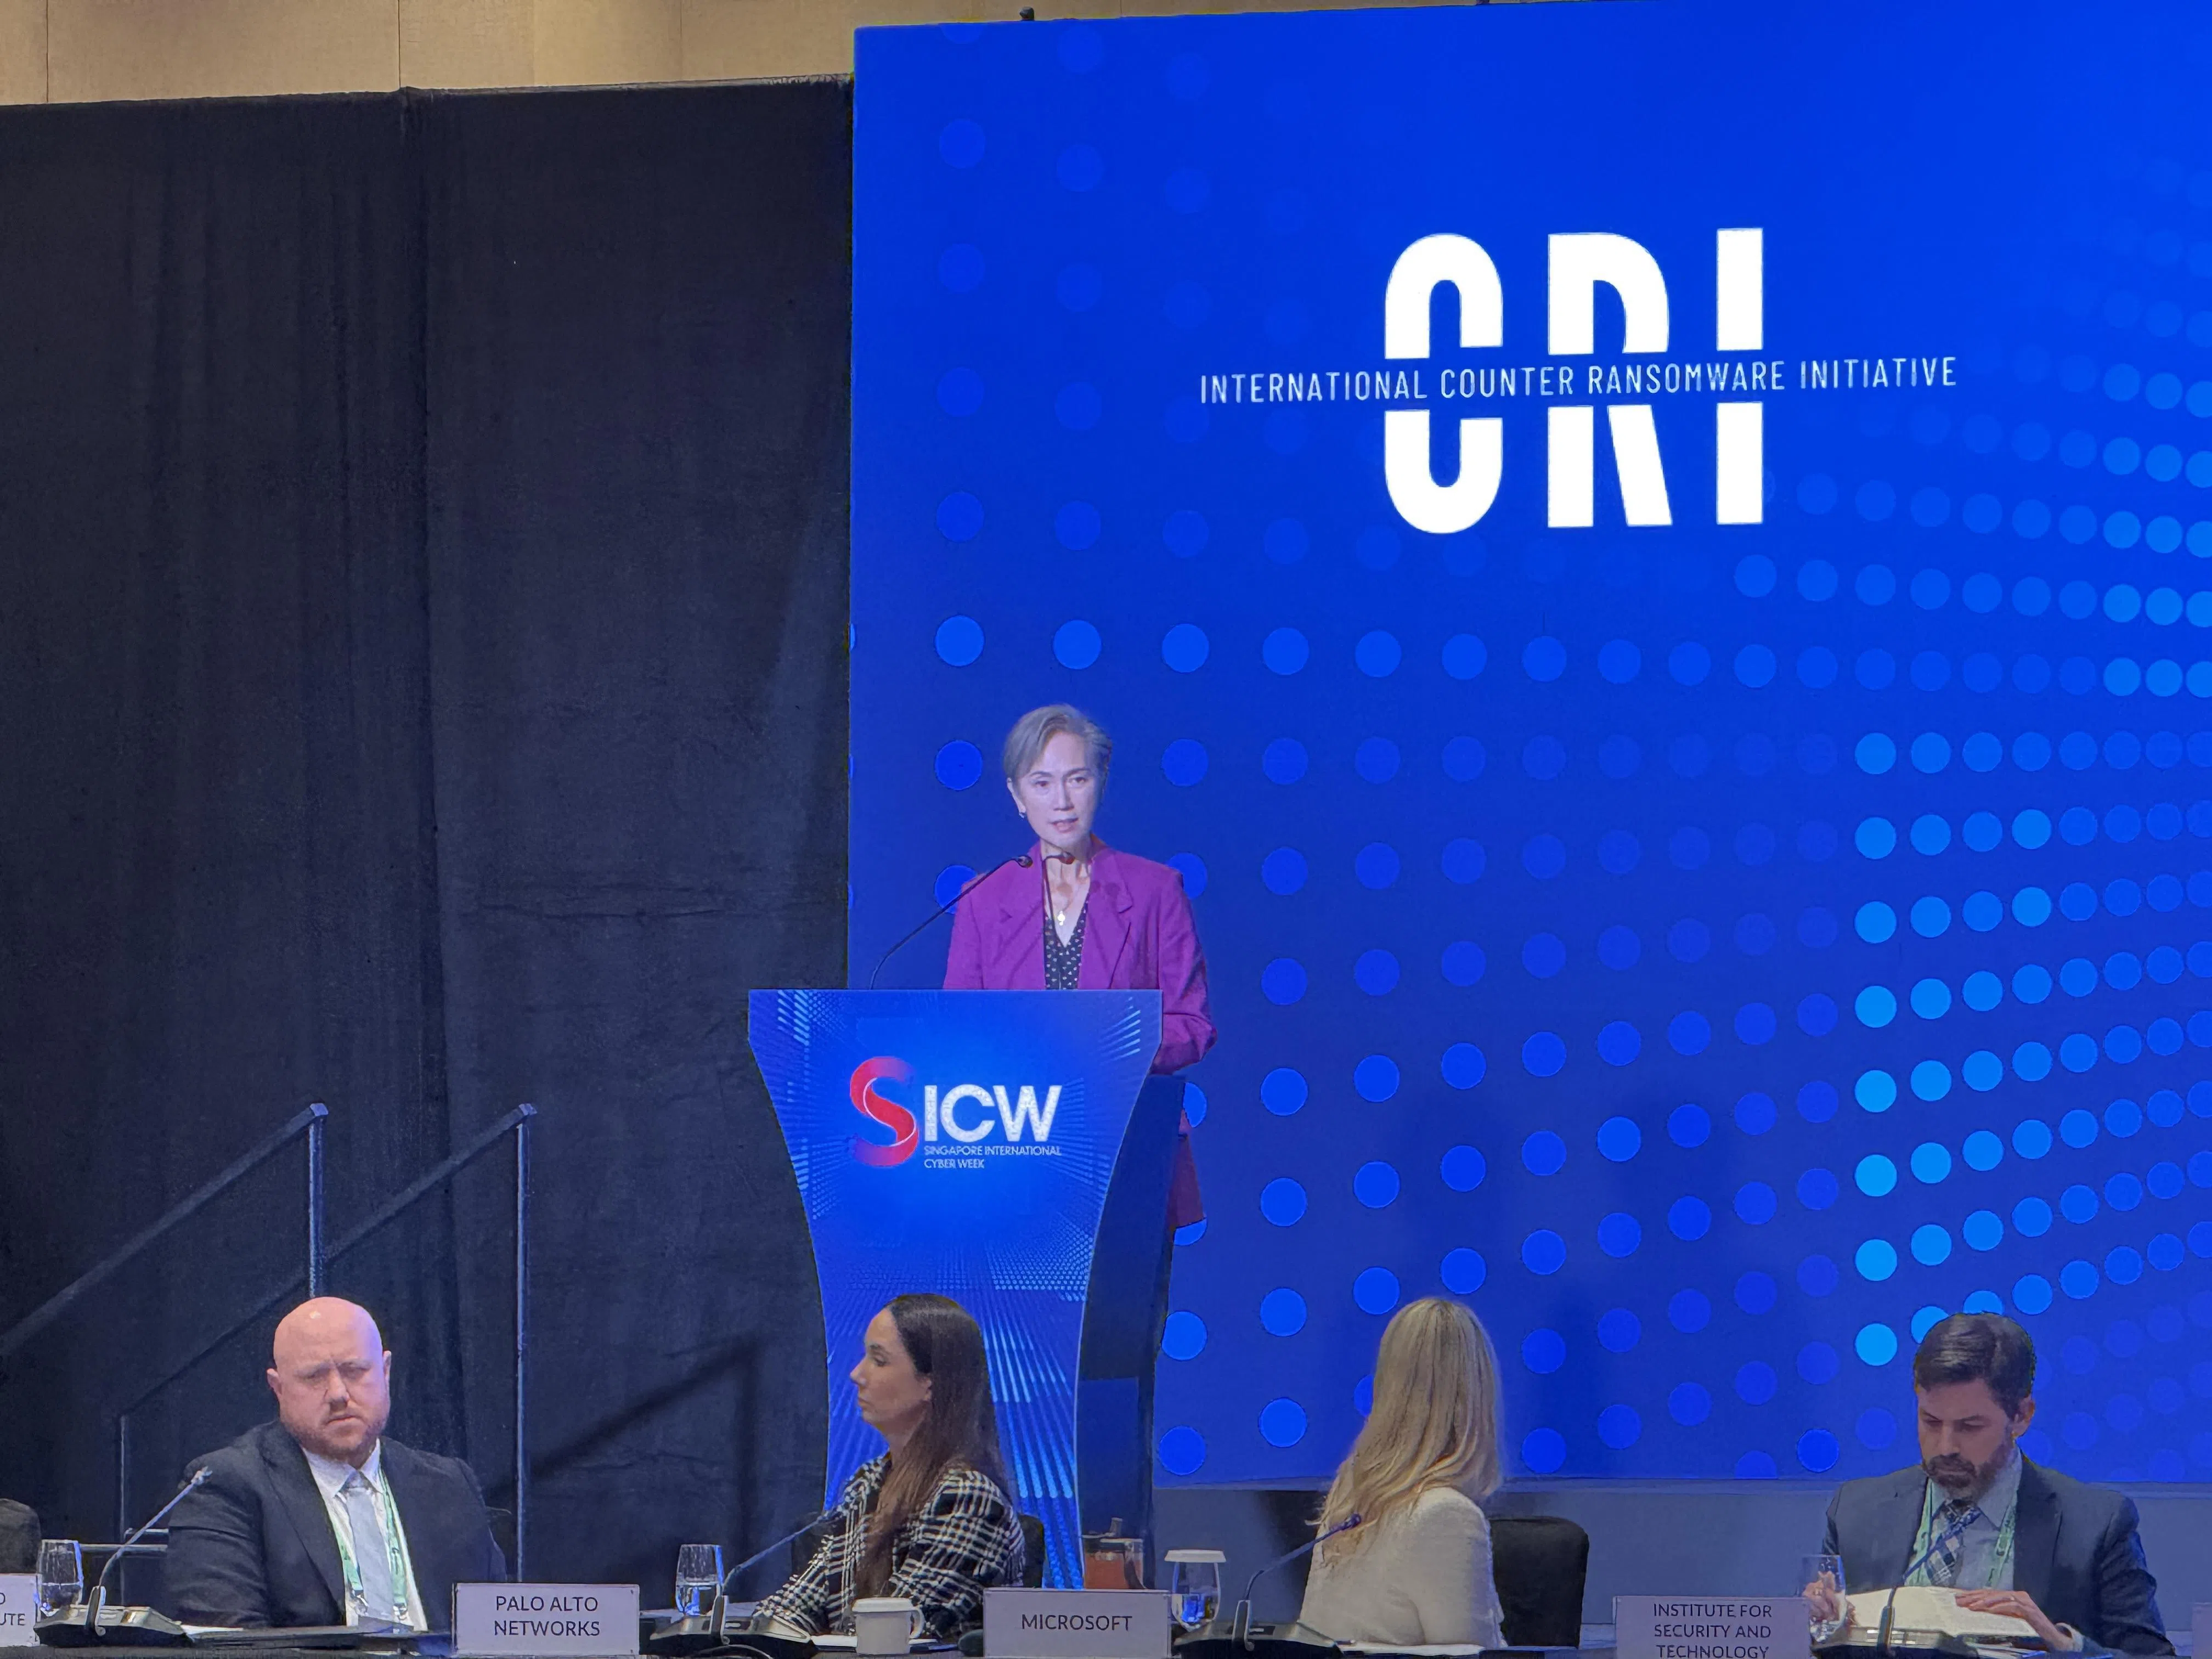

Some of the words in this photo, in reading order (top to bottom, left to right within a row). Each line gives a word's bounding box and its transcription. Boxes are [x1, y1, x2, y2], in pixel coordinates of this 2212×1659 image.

[1201, 370, 1427, 403] INTERNATIONAL
[1441, 366, 1573, 398] COUNTER
[1589, 360, 1785, 394] RANSOMWARE
[1801, 357, 1956, 388] INITIATIVE
[1384, 227, 1763, 534] CRI
[924, 1145, 983, 1156] SINGAPORE
[985, 1145, 1062, 1156] INTERNATIONAL
[924, 1158, 956, 1169] CYBER
[958, 1158, 985, 1169] WEEK
[496, 1595, 544, 1611] PALO
[550, 1596, 598, 1612] ALTO
[1654, 1603, 1736, 1618] INSTITUTE
[1740, 1605, 1772, 1618] FOR
[494, 1620, 600, 1637] NETWORKS
[1021, 1614, 1133, 1631] MICROSOFT
[1654, 1623, 1731, 1638] SECURITY
[1735, 1625, 1771, 1638] AND
[1656, 1645, 1769, 1658] TECHNOLOGY
